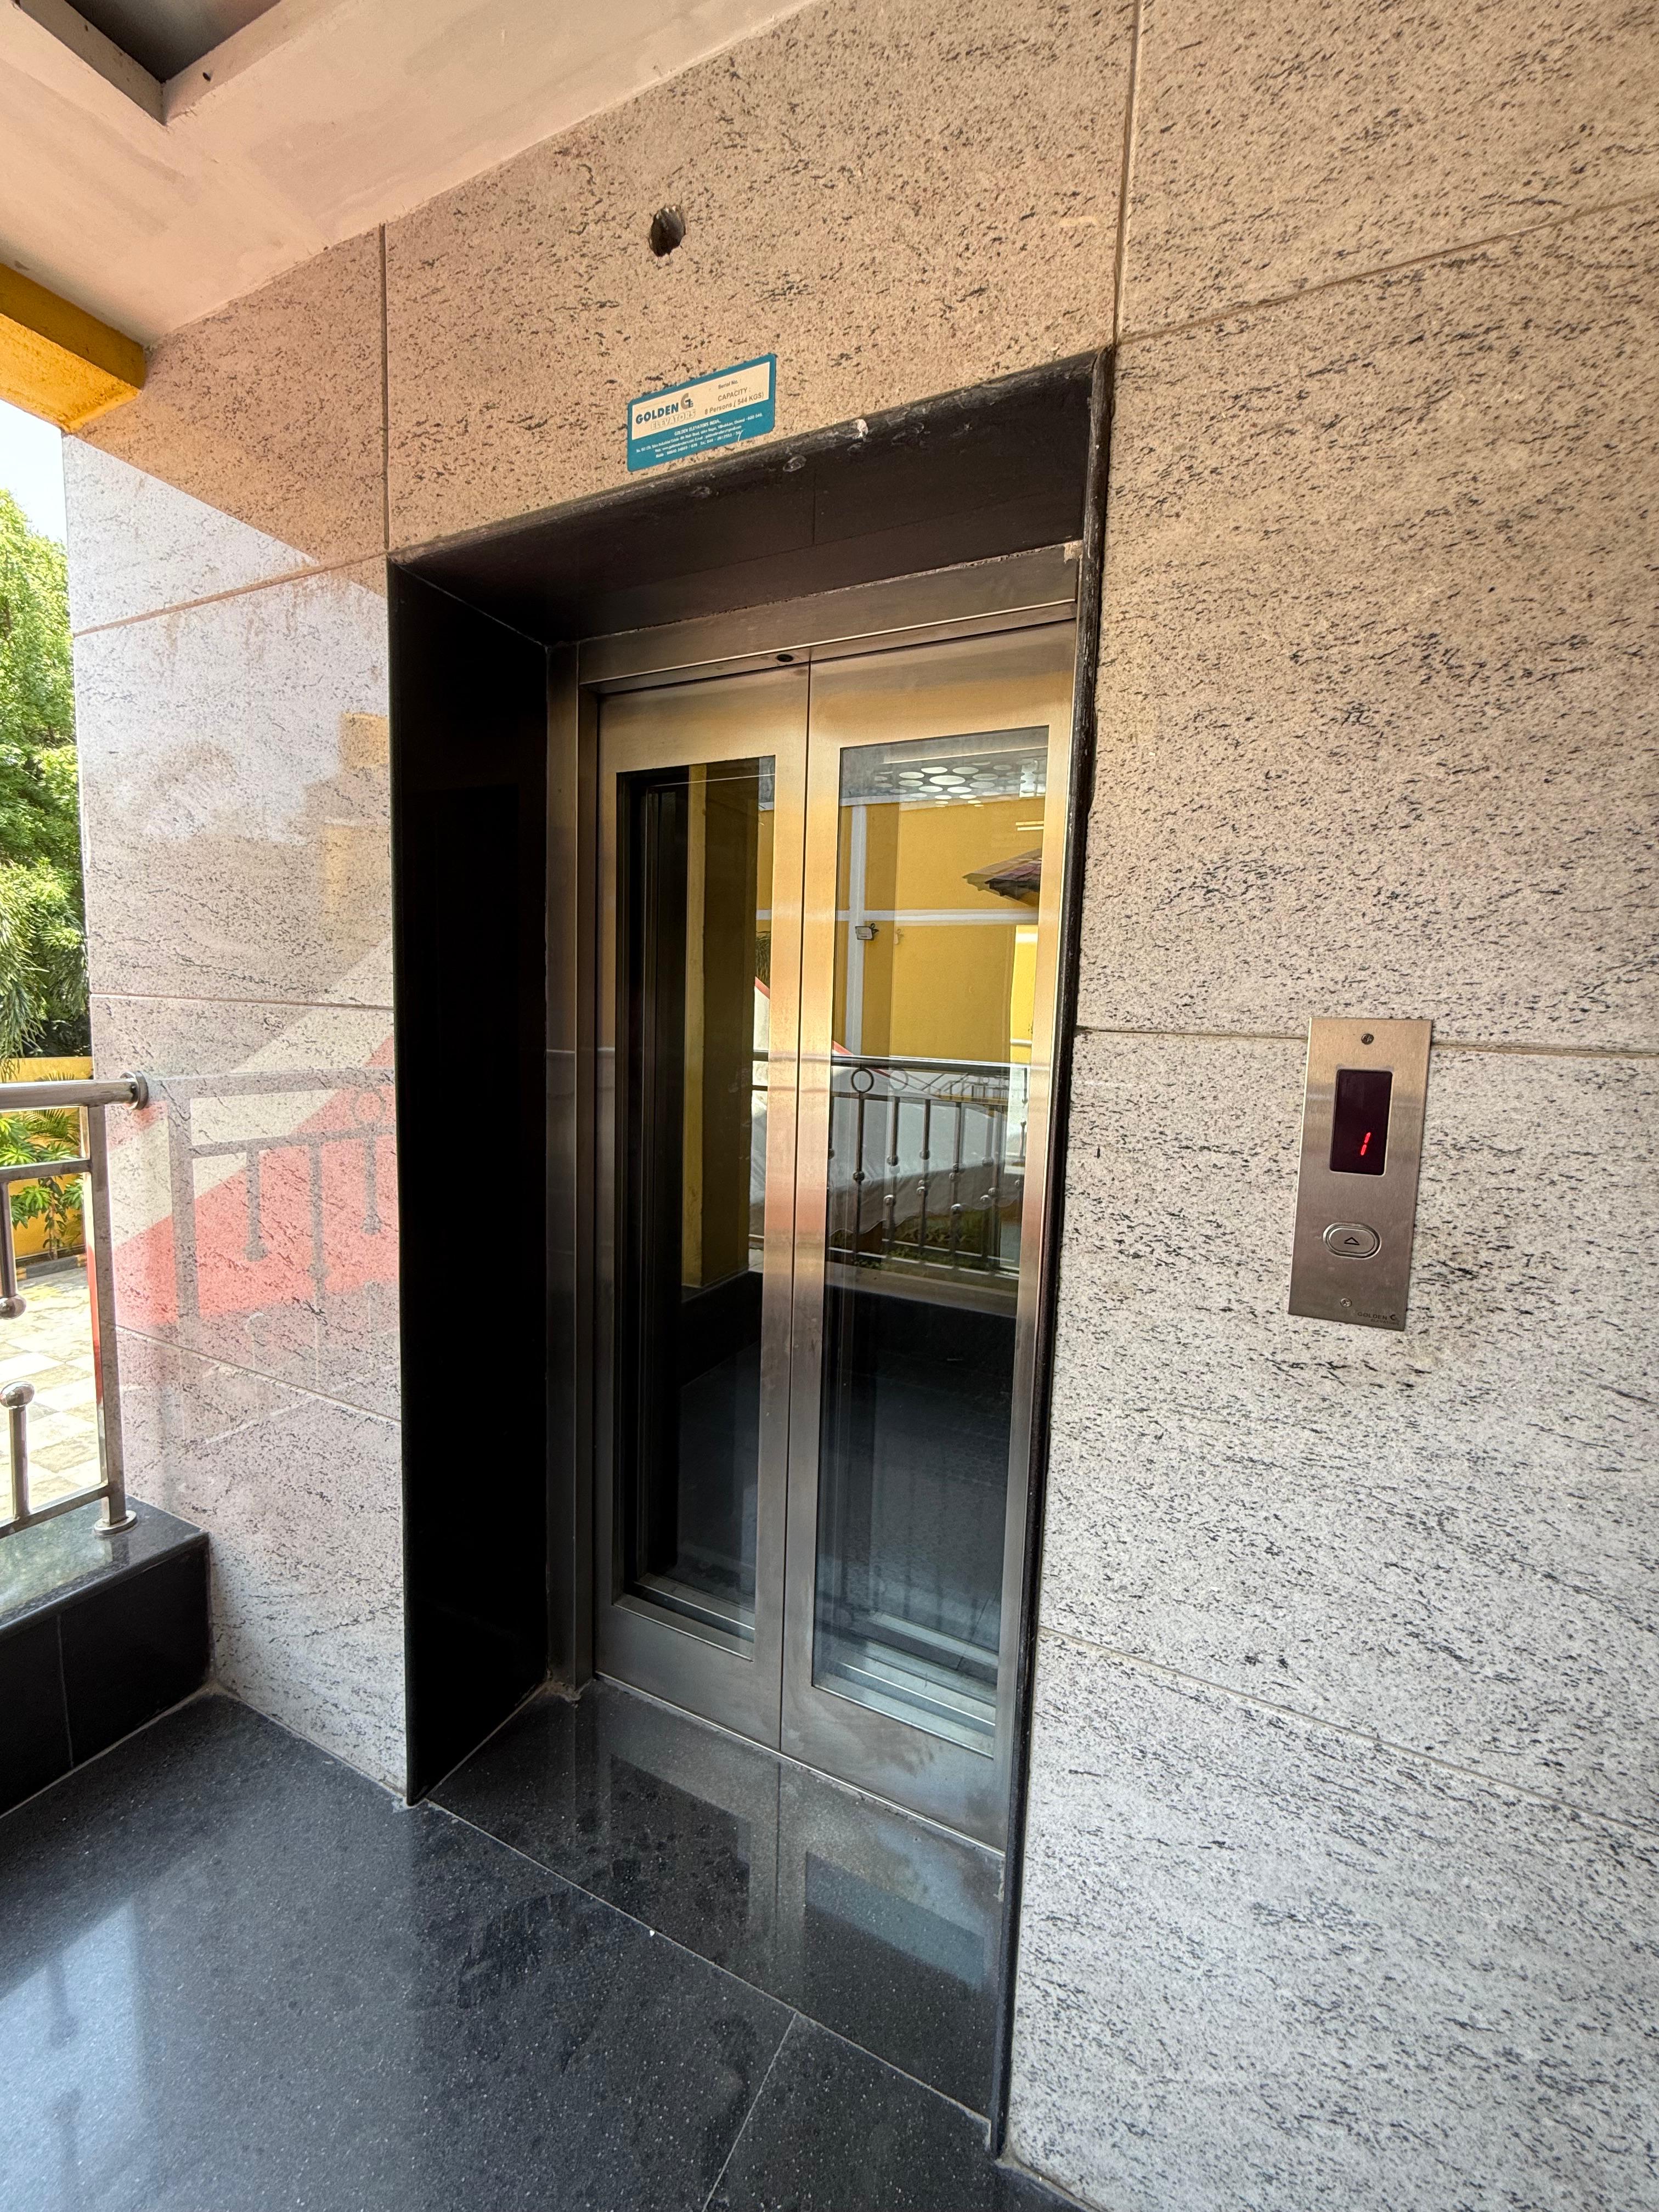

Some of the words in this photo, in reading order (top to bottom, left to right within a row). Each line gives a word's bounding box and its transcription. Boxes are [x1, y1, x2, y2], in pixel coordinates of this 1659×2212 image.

[718, 381, 731, 390] Serial
[718, 387, 748, 402] CAPACITY
[635, 402, 679, 425] GOLDEN
[709, 402, 732, 414] Persons
[737, 397, 748, 405] 544
[749, 391, 764, 402] KGS)
[651, 409, 696, 431] ELEVATORS
[1359, 1131, 1372, 1156] 1
[1357, 1311, 1387, 1321] GOLDEN
